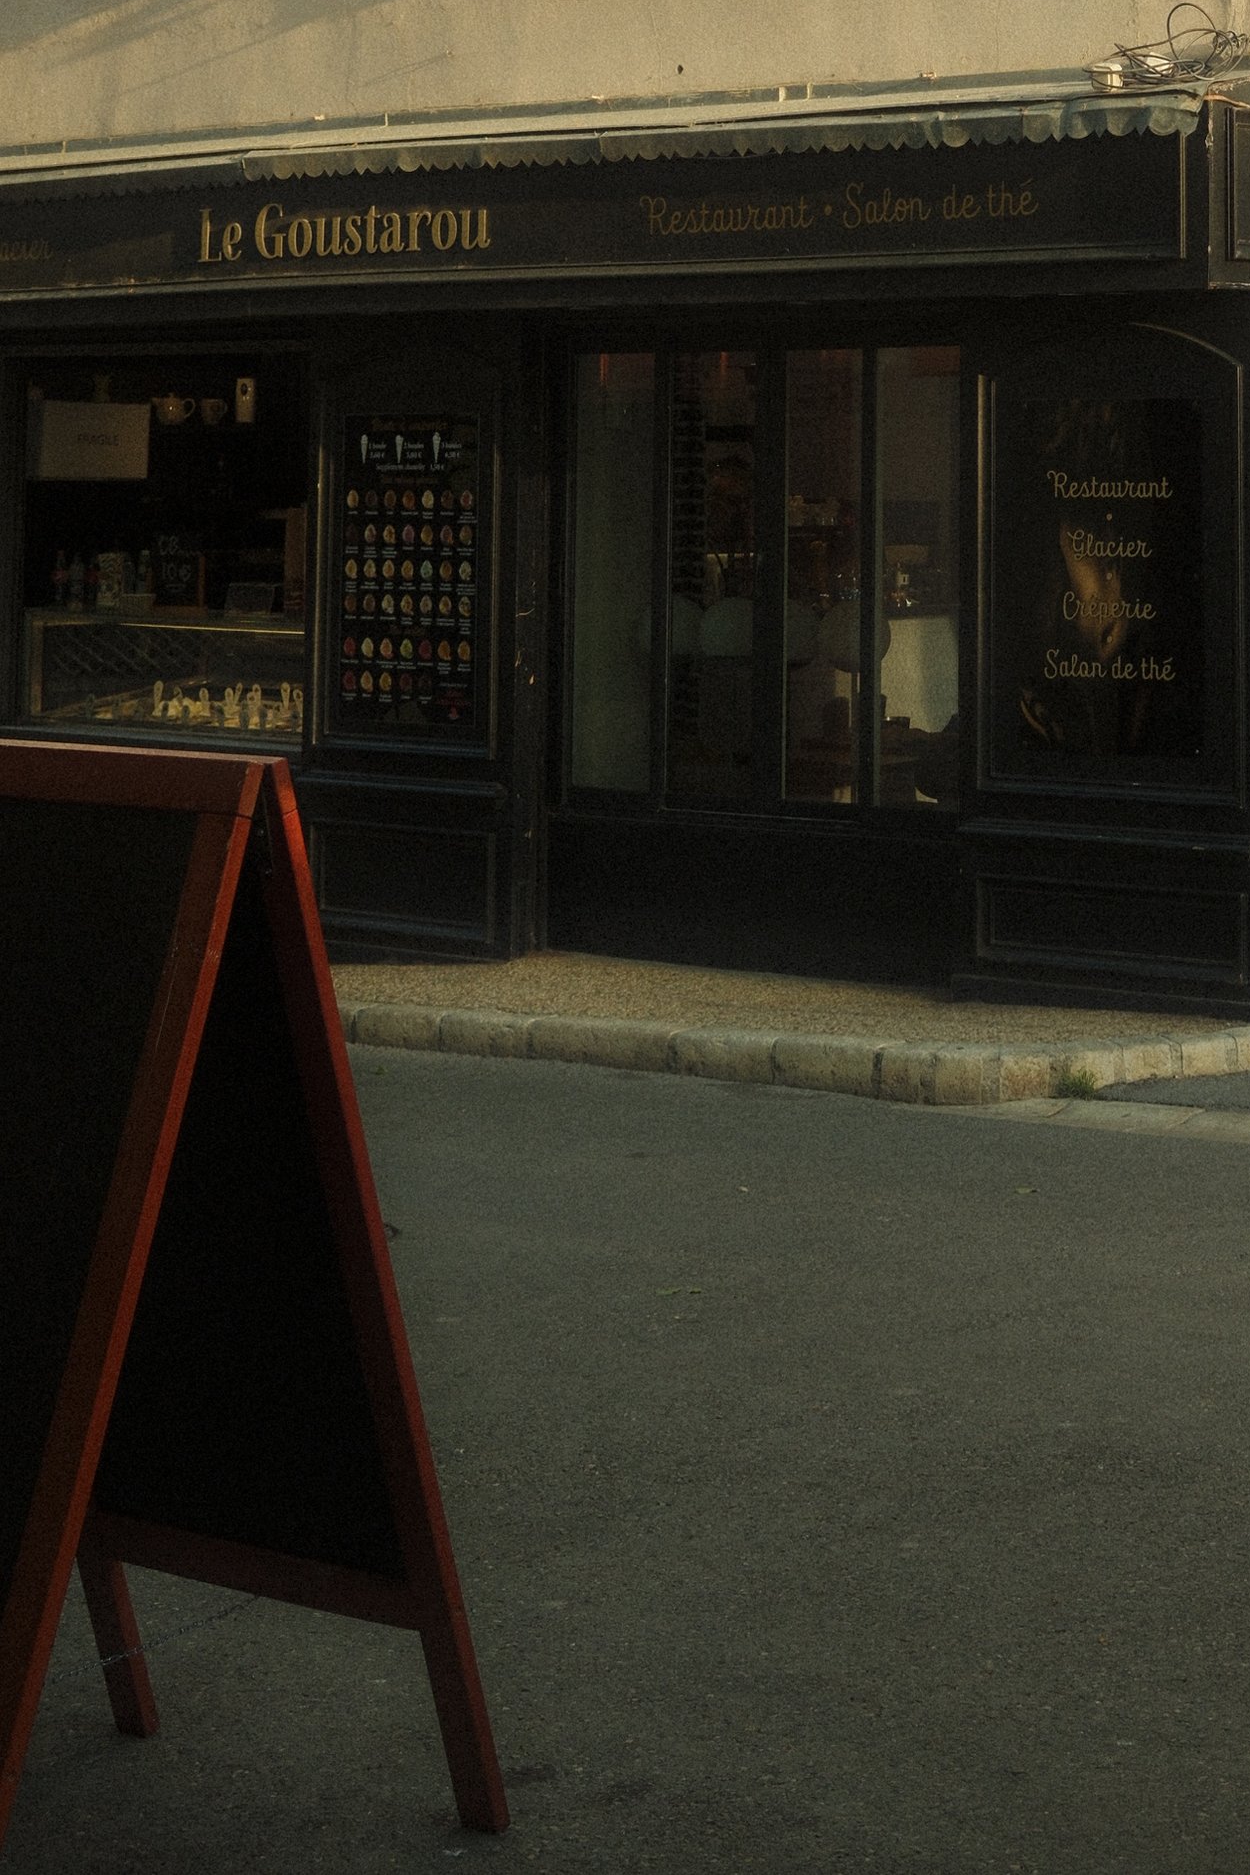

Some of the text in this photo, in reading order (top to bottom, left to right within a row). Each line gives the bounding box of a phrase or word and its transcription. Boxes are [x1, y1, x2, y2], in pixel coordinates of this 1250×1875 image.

[639, 178, 1039, 236] Restaurant Salon de thé
[197, 203, 491, 263] Le Goustarou
[1047, 469, 1173, 500] Restaurant
[1067, 529, 1152, 560] Glacier
[1062, 591, 1157, 623] Crêperie
[1043, 649, 1176, 682] Salon de thé
